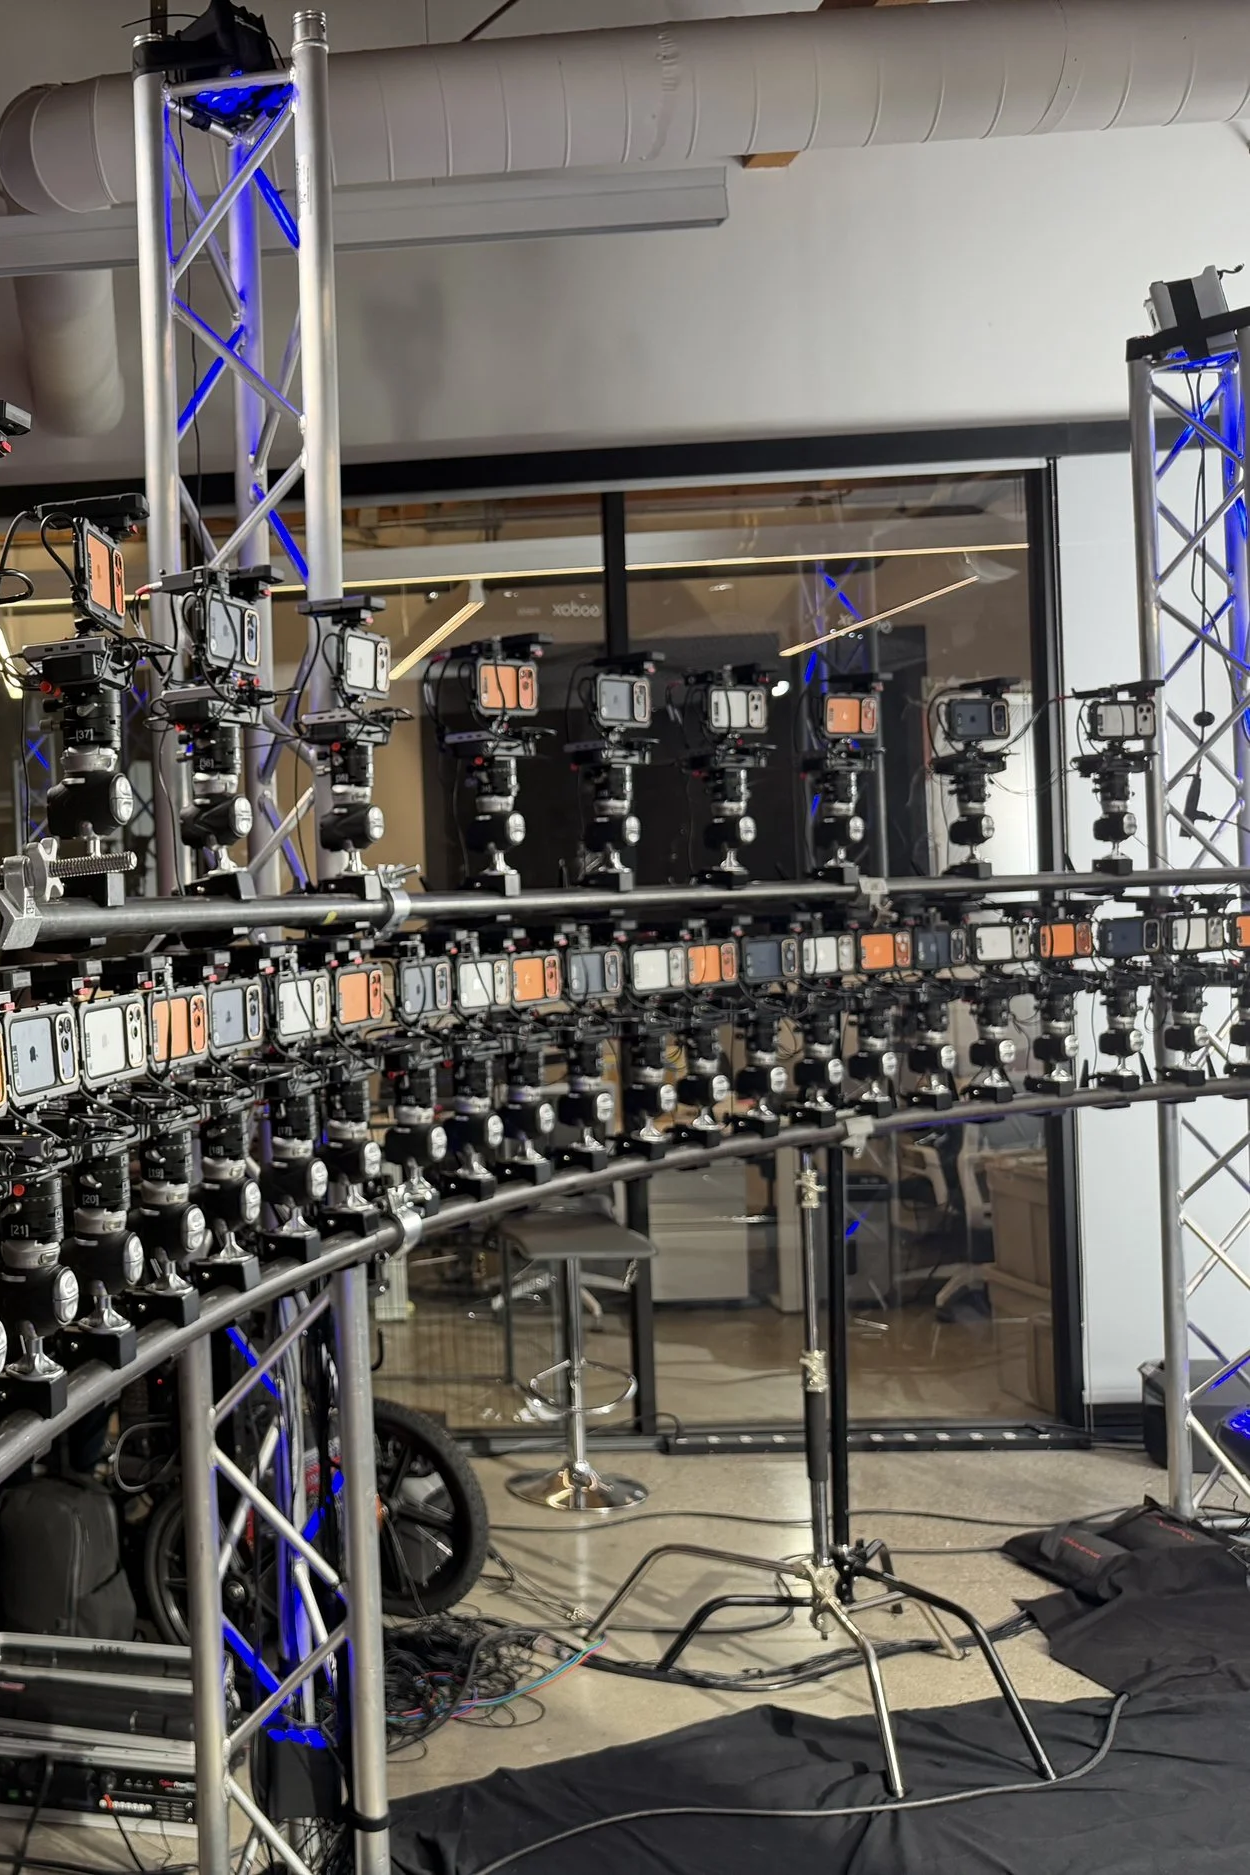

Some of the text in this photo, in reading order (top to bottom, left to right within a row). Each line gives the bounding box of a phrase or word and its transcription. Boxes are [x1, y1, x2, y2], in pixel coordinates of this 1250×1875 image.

[75, 728, 94, 742] [37]
[148, 1168, 164, 1180] [19]
[82, 1193, 100, 1206] [20]
[10, 1224, 29, 1238] [21]
